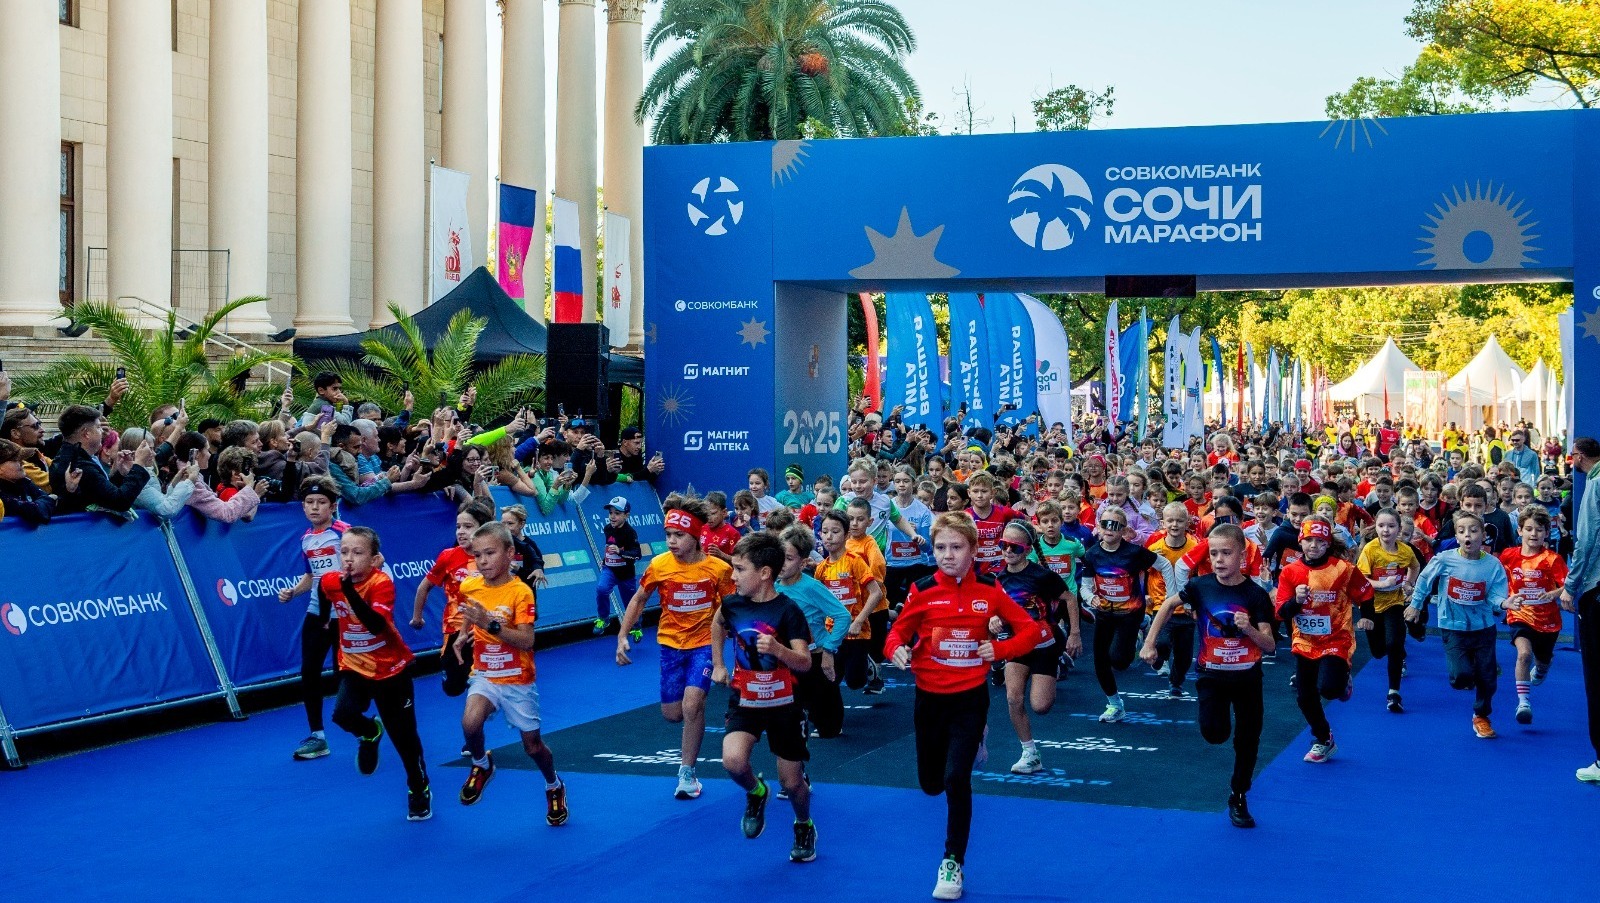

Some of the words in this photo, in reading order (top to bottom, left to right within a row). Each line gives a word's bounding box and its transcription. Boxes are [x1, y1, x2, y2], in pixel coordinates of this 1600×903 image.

[1105, 163, 1262, 181] СОВКОМБАНК
[1104, 185, 1262, 222] СОЧИ
[1105, 222, 1262, 243] МАРАФОН
[687, 300, 758, 310] СОВКОМБАНК
[702, 366, 750, 376] МАГНИТ
[707, 431, 749, 439] МАГНИТ
[708, 442, 749, 451] АПТЕКА
[521, 522, 551, 536] СШАЯ
[553, 519, 578, 533] ЛИГА
[642, 513, 662, 526] ЛИГА
[668, 512, 692, 528] 25
[1311, 524, 1329, 537] 25
[393, 558, 437, 580] СОВКО
[237, 575, 303, 599] СОВКОМ
[29, 592, 168, 627] СОВКОМБАНК
